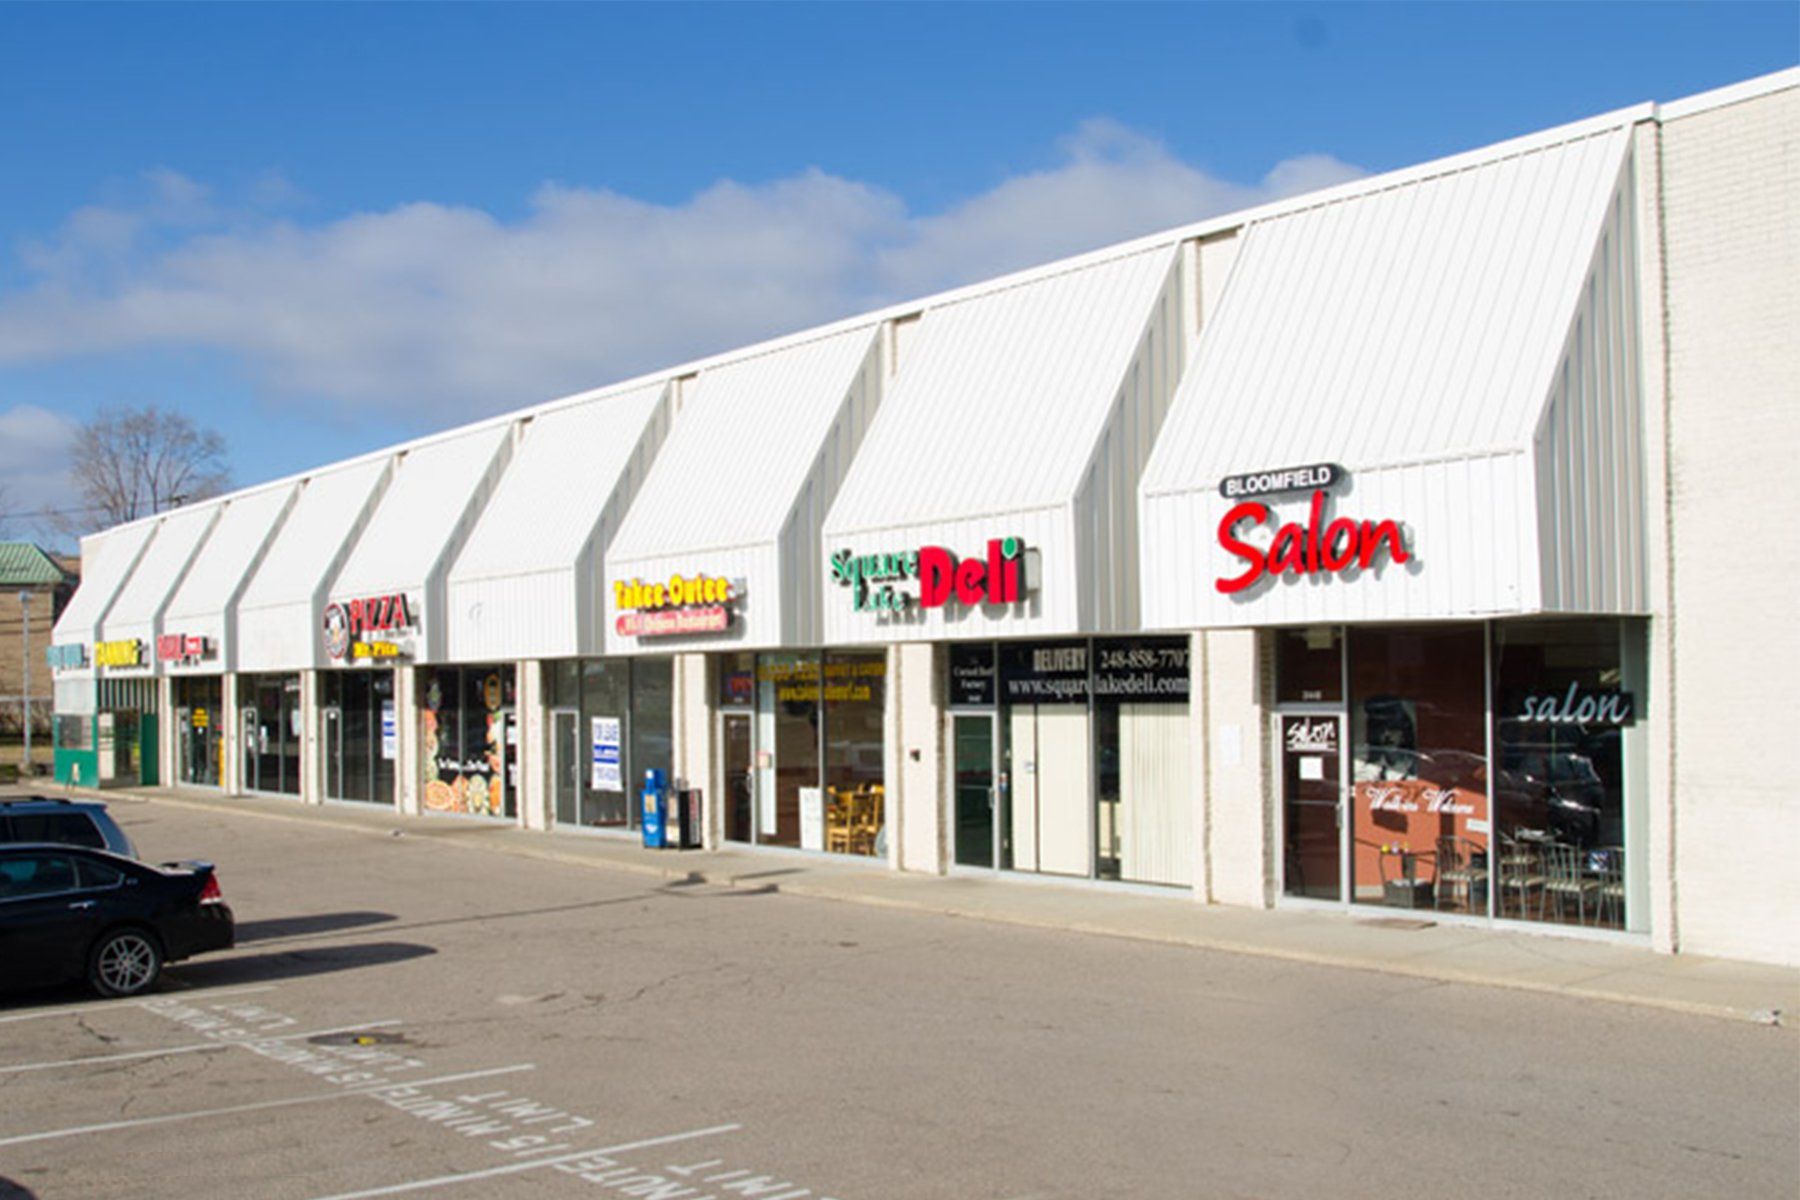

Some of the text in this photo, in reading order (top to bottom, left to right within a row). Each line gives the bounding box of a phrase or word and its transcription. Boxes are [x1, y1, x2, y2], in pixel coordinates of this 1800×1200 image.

[1225, 466, 1331, 496] BLOOMFIELD
[1215, 489, 1410, 594] Salon
[919, 536, 1018, 609] Deli
[350, 593, 406, 634] PIZZA
[1518, 680, 1630, 722] salon
[367, 1086, 513, 1138] MINUTE
[455, 1090, 595, 1134] LIMIT
